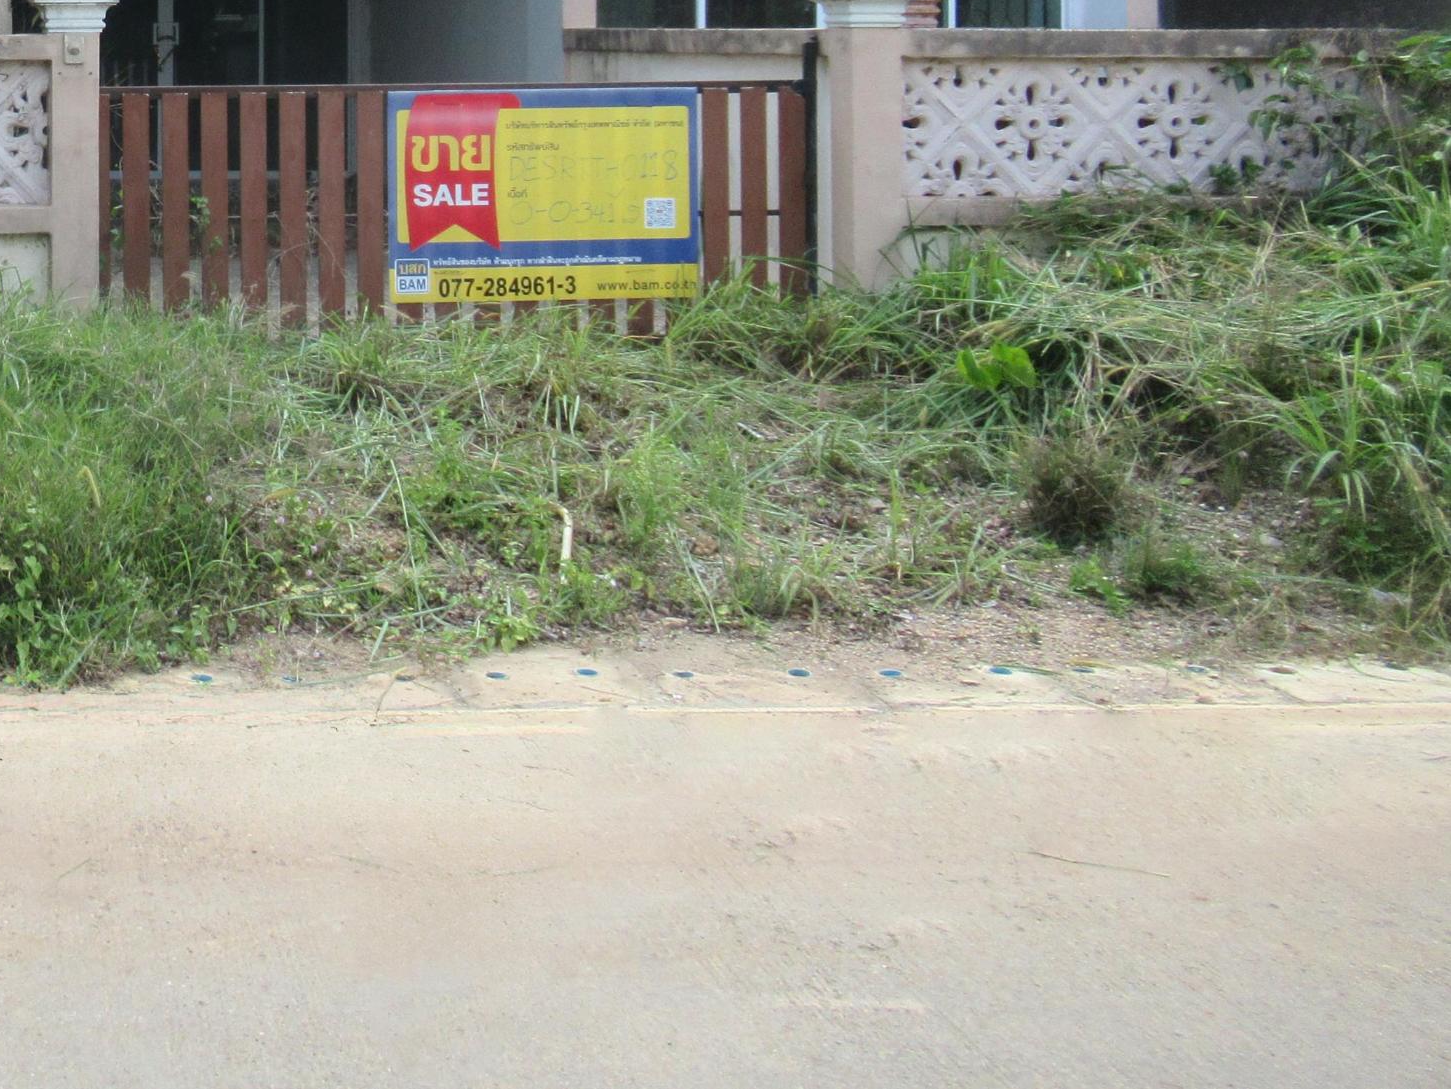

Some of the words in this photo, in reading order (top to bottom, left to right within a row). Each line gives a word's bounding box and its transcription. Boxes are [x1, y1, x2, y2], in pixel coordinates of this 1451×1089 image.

[411, 134, 491, 173] ขาย
[413, 183, 490, 207] SALE
[399, 262, 427, 275] บสก
[399, 279, 426, 291] BAM
[439, 276, 577, 298] 077-284961-3
